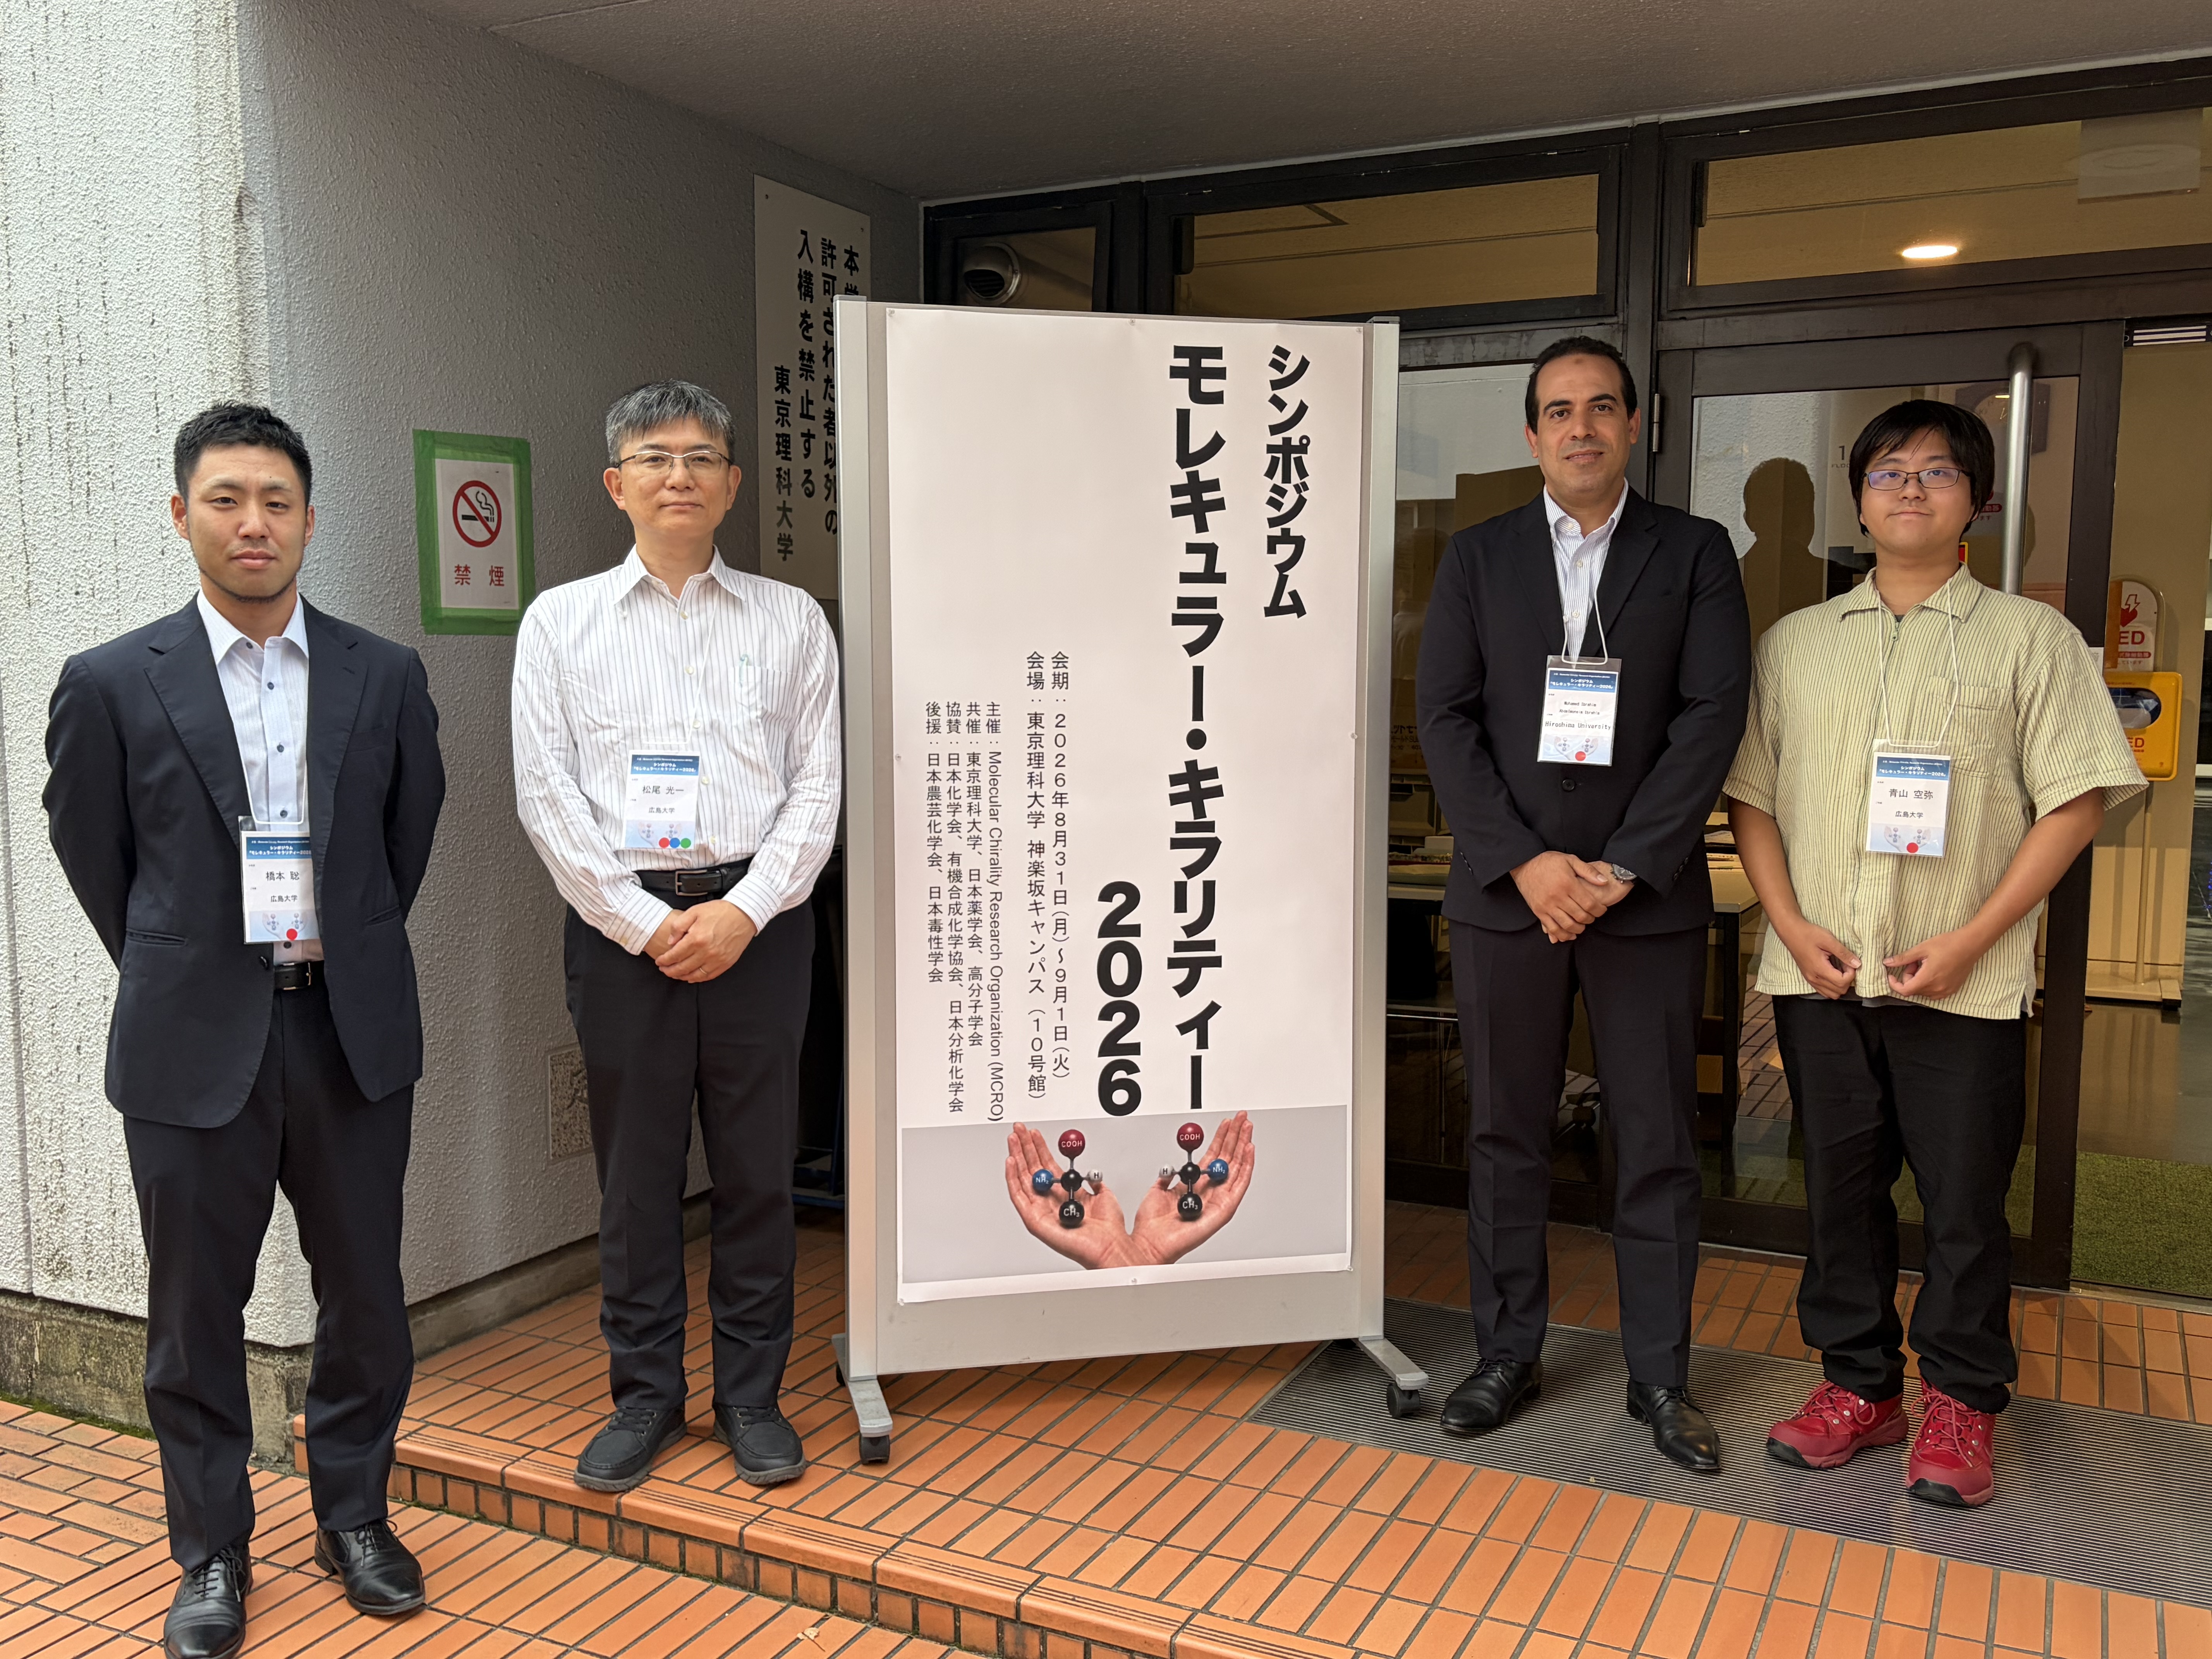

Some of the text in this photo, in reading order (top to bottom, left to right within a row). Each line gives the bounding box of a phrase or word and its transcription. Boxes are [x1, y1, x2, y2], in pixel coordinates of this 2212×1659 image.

[797, 229, 815, 498] 入構を禁止する
[821, 237, 837, 535] 許可された者以外の
[775, 365, 793, 562] 東京理科大学
[1263, 345, 1311, 619] シンポジウム
[2119, 630, 2145, 645] ED
[1167, 345, 1227, 1110] モレキュラー・キラリティー
[1578, 722, 1611, 731] University
[642, 785, 684, 795] 松尾 光一
[1889, 788, 1933, 800] 青山 空弥
[1895, 811, 1923, 819] 広島大学
[266, 871, 300, 881] 橋本 聡
[986, 828, 1002, 886] Chirality
[989, 891, 1003, 960] Research
[1027, 840, 1046, 994] 神楽坂キャンパス
[987, 965, 1003, 1057] Organization
[1096, 881, 1143, 1117] 2026
[988, 1062, 1004, 1121] (MCRO)
[1061, 1140, 1082, 1148] COOH
[1180, 1133, 1200, 1141] COOH
